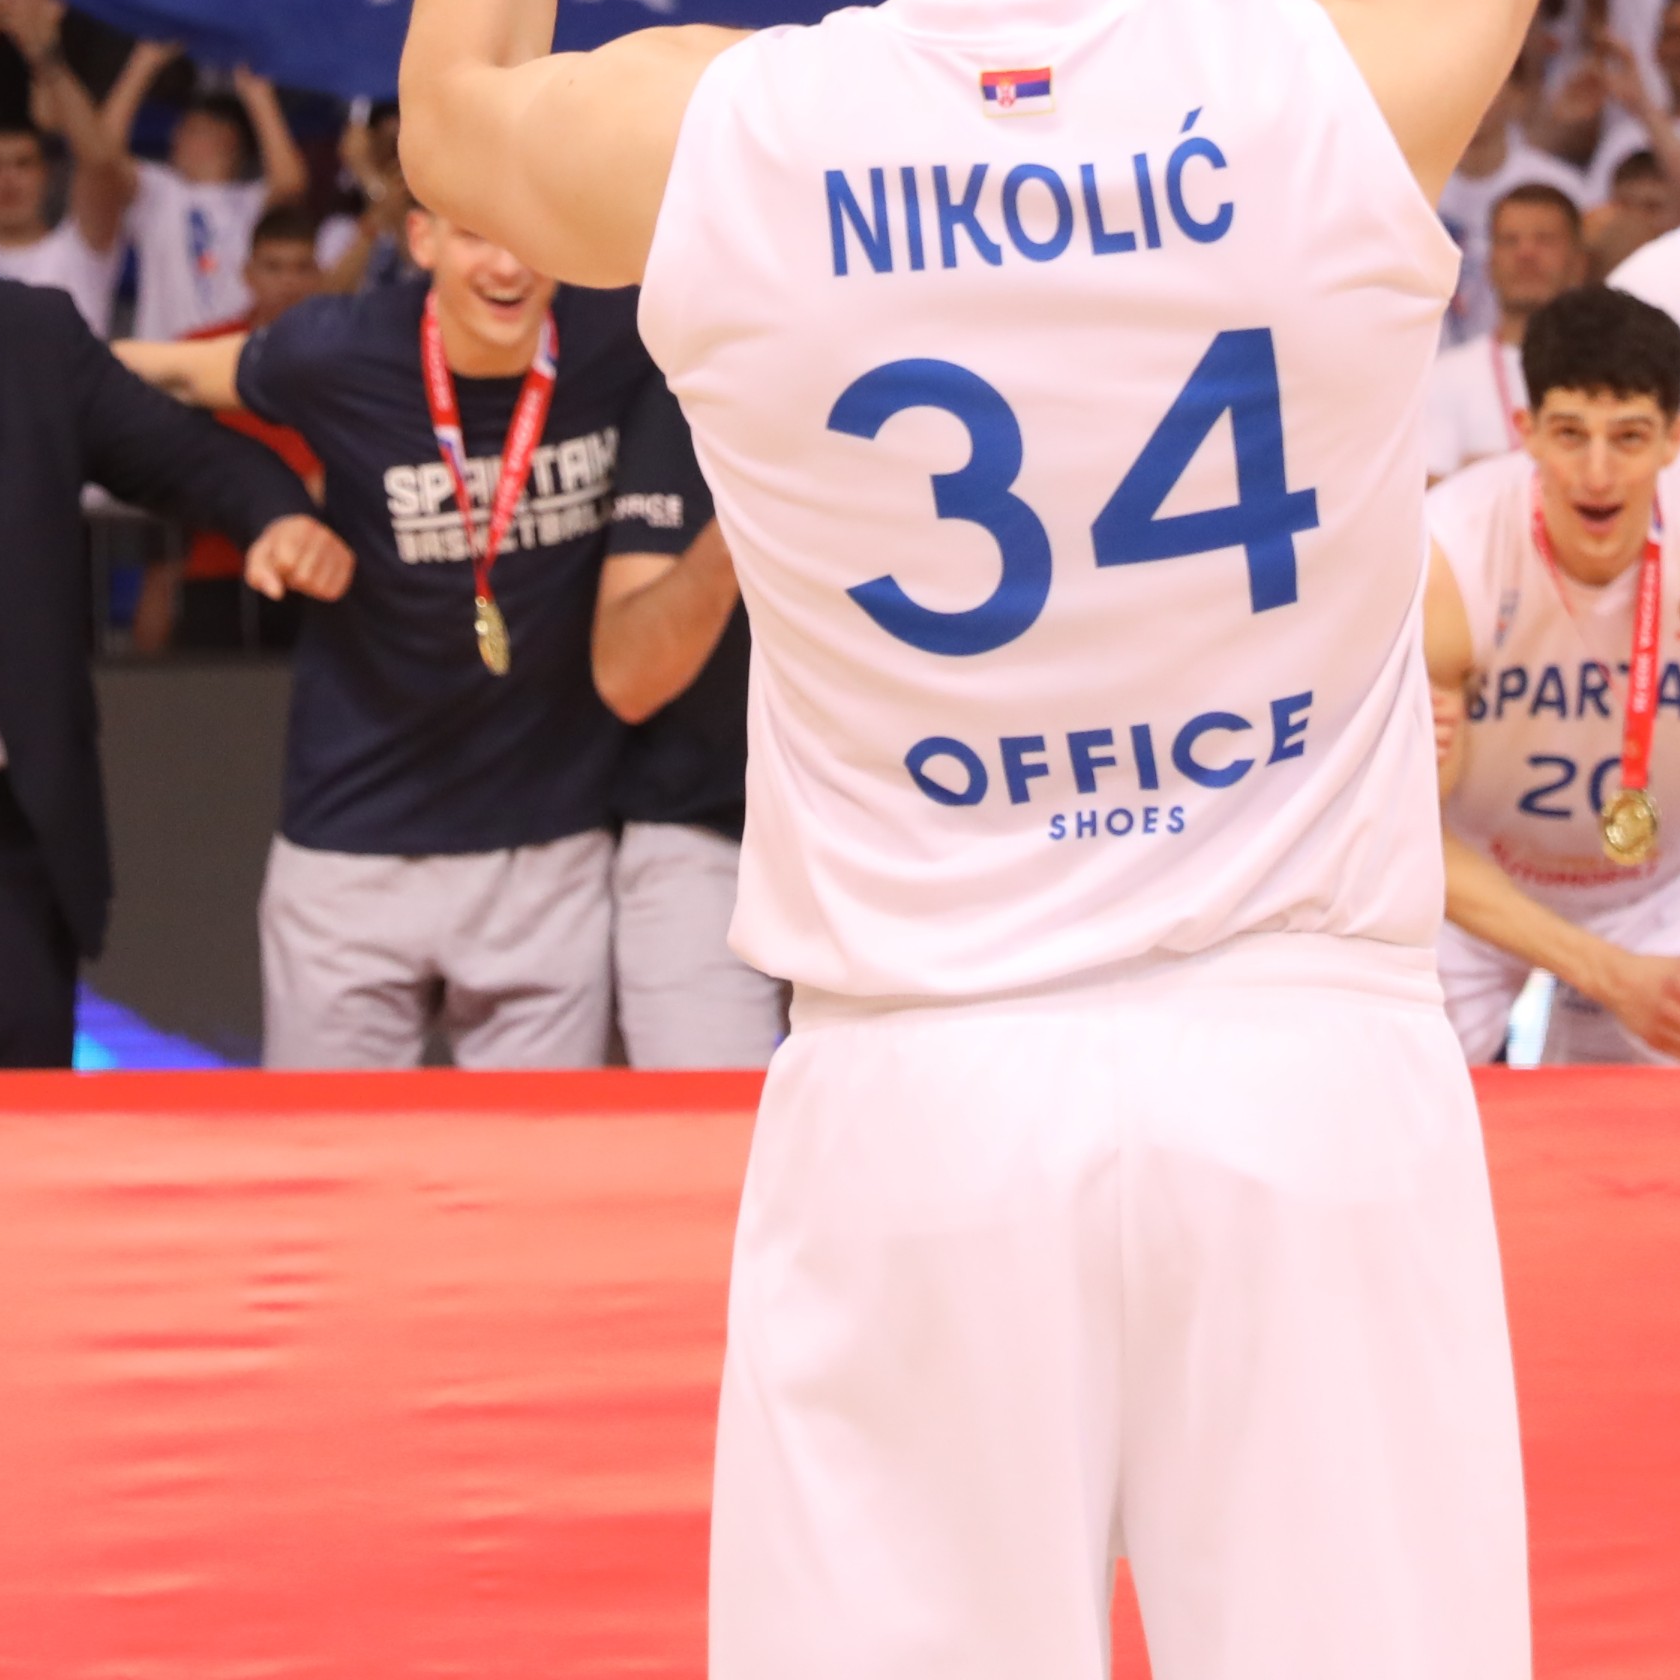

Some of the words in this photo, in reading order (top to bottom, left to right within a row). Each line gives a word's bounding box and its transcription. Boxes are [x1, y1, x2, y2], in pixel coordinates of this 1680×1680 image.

[823, 105, 1235, 277] NIKOLIĆ
[825, 326, 1321, 658] 34
[902, 689, 1314, 807] OFFICE
[1047, 804, 1186, 841] SHOES
